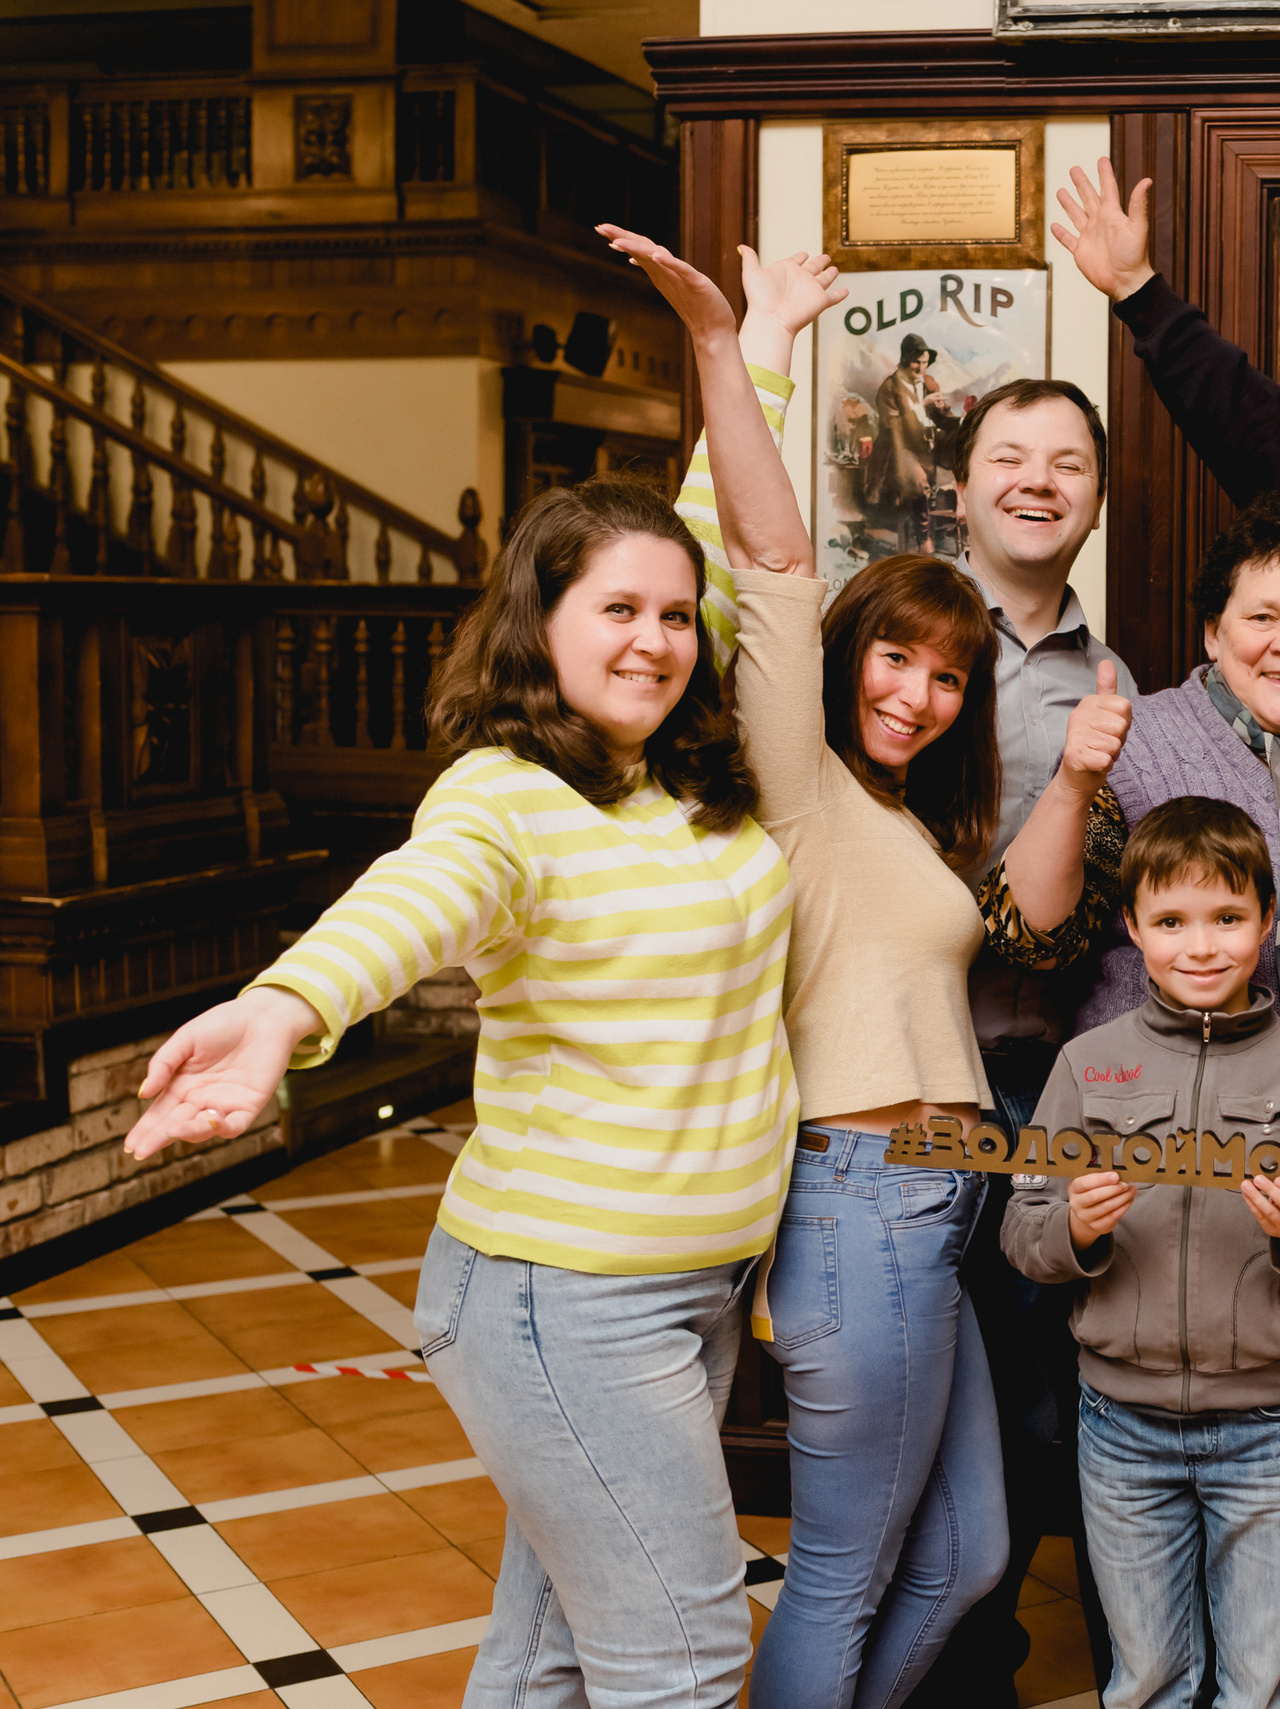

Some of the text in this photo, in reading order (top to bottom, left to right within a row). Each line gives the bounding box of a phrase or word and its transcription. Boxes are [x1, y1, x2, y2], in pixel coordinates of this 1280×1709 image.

[844, 273, 1015, 336] OLD RIP
[1084, 1066, 1112, 1083] Cool
